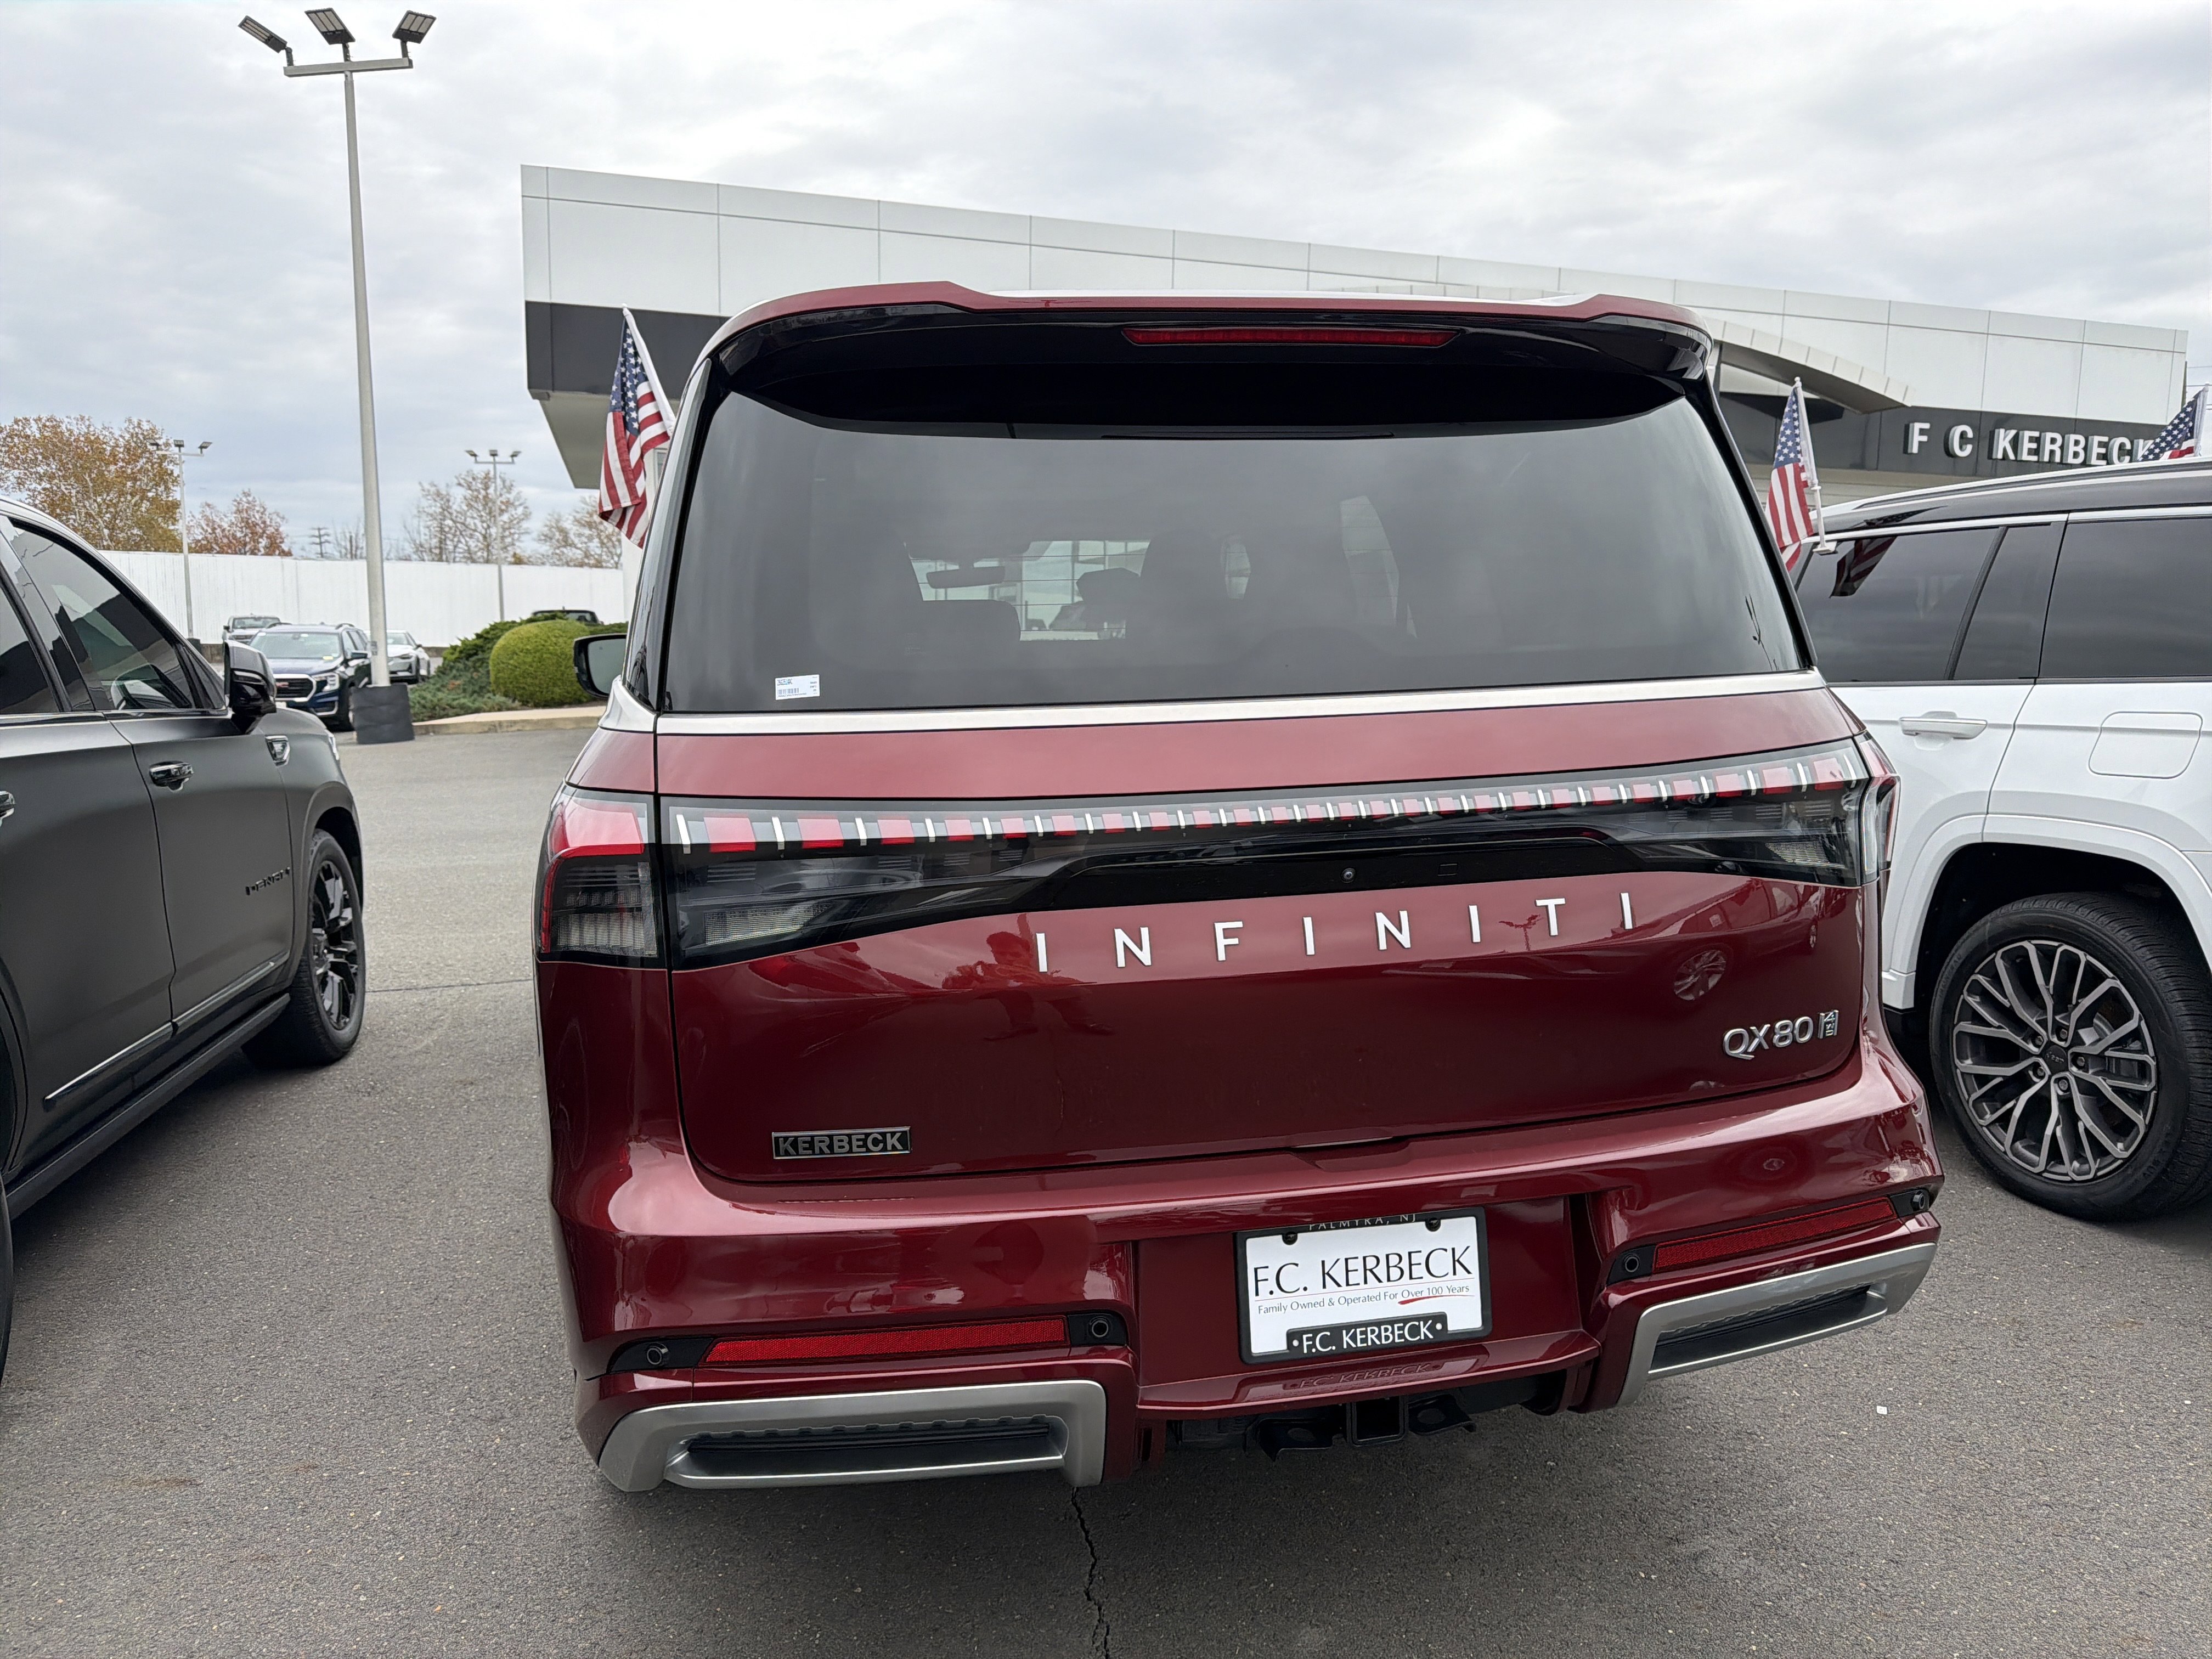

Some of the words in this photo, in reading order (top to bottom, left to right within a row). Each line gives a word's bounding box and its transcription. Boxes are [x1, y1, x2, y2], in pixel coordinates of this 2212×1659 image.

[1906, 422, 1930, 454] F
[1948, 425, 1974, 458] C
[1035, 891, 1634, 973] INFINITI
[1723, 1016, 1814, 1060] QX80
[778, 1132, 904, 1156] KERBECK
[1254, 1262, 1308, 1296] F.C.
[1321, 1245, 1473, 1289] KERBECK
[1258, 1301, 1288, 1314] Family
[1290, 1297, 1325, 1311] Owned
[1328, 1299, 1335, 1307] &
[1338, 1294, 1381, 1307] Operated
[1384, 1291, 1398, 1301] For
[1401, 1289, 1424, 1299] Over
[1426, 1286, 1443, 1296] 100
[1446, 1284, 1470, 1294] Years
[1302, 1331, 1336, 1354] F.C.
[1342, 1319, 1434, 1349] KERBECK
